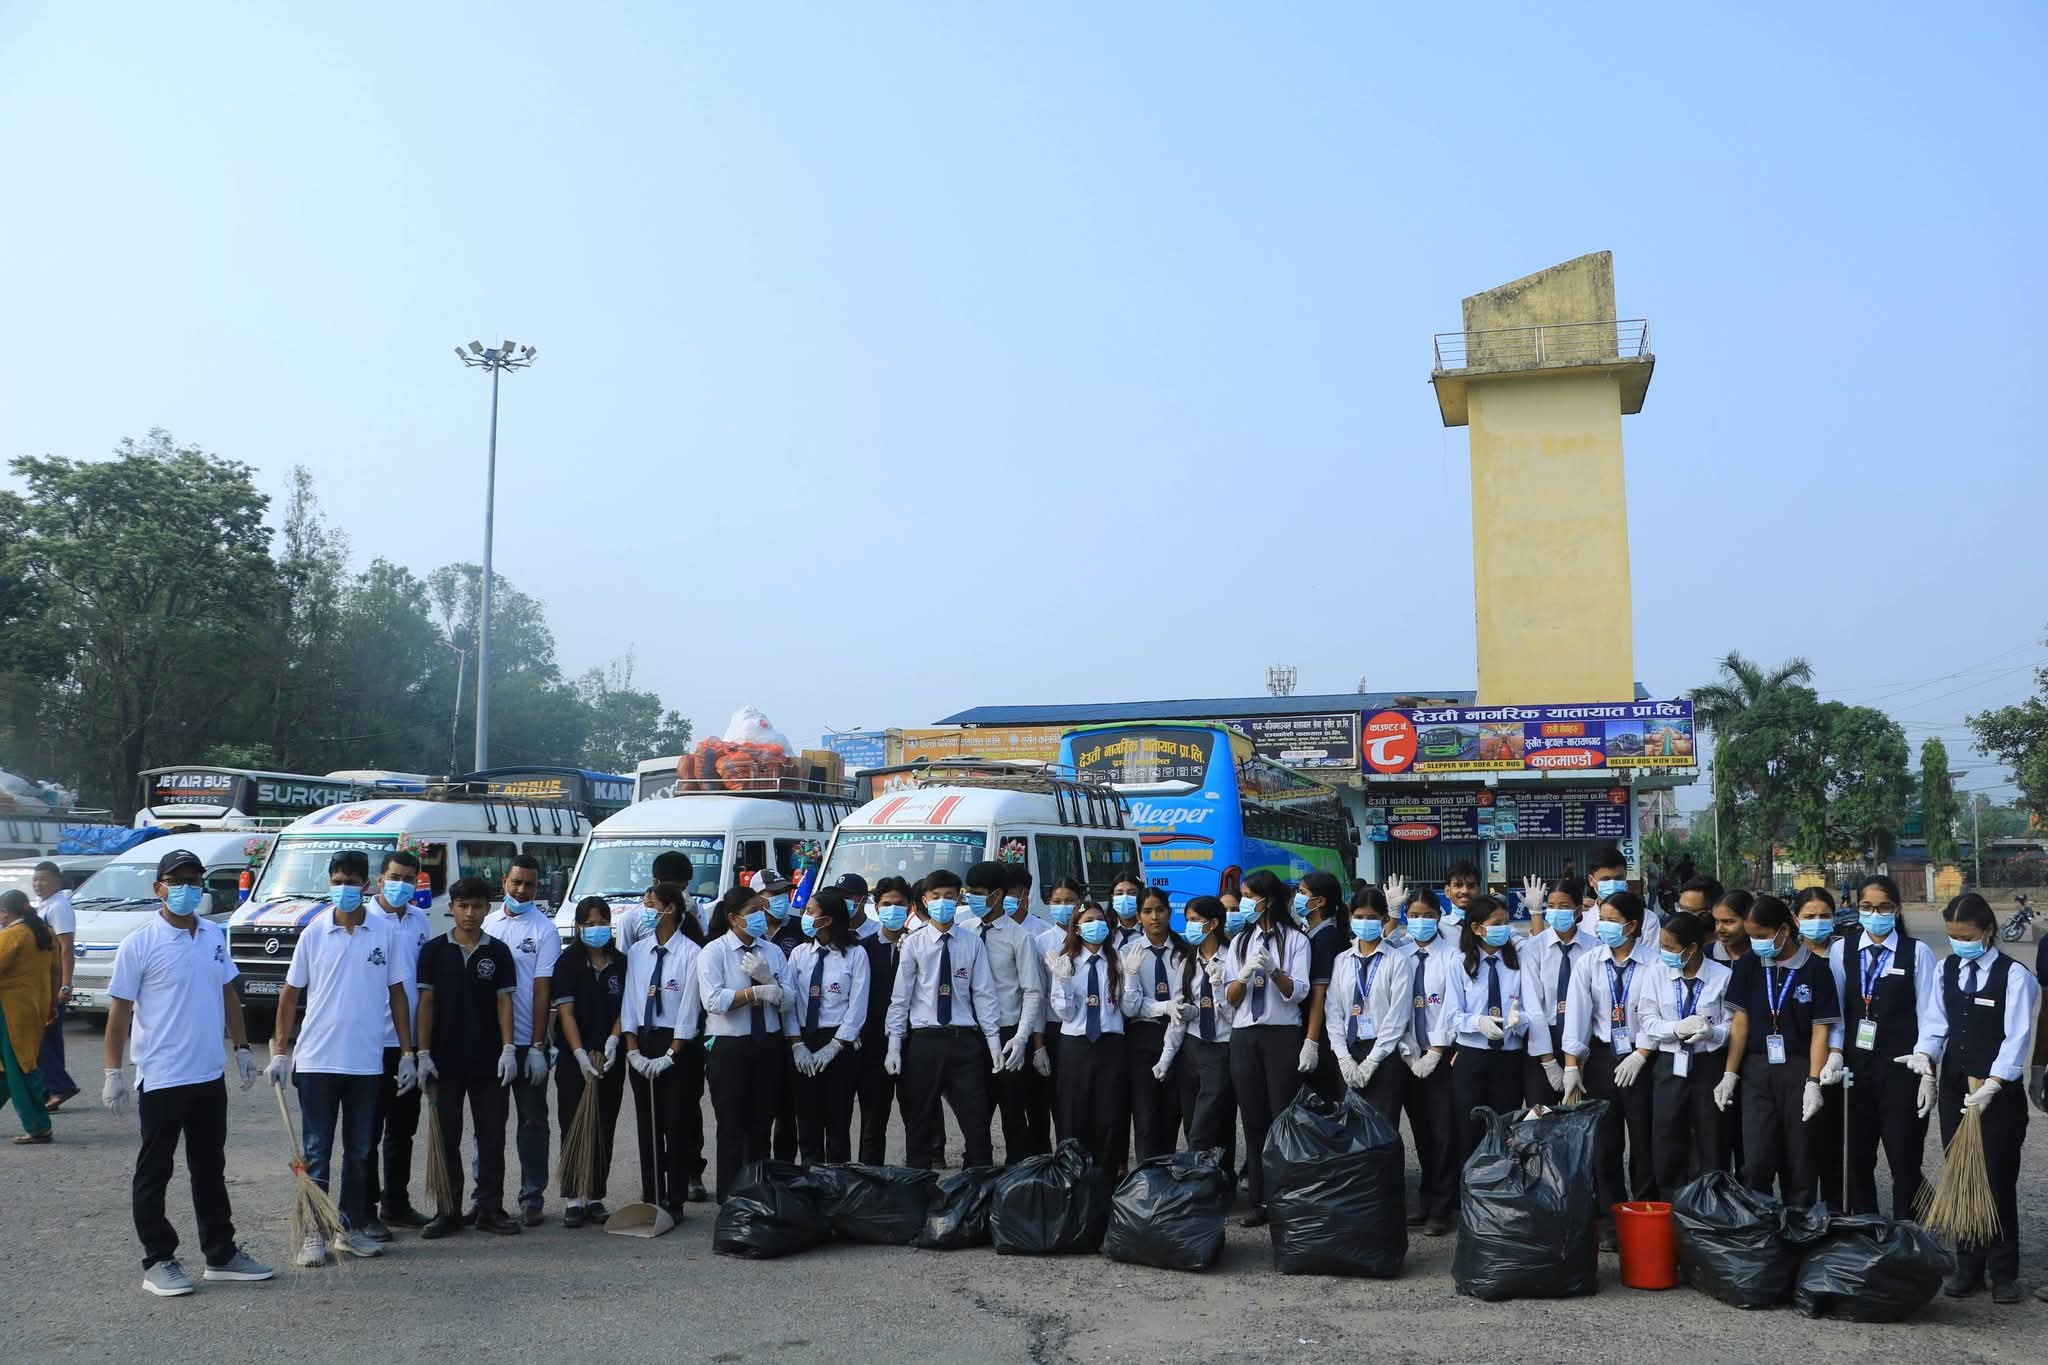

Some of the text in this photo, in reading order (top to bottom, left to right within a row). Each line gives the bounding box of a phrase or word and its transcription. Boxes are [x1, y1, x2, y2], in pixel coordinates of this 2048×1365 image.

[1411, 709, 1460, 723] देउती
[1465, 707, 1541, 721] नागरिक
[1546, 706, 1627, 719] यातायात
[1079, 745, 1101, 768] देउती
[203, 775, 232, 788] BUS
[1130, 801, 1215, 826] Sleeper
